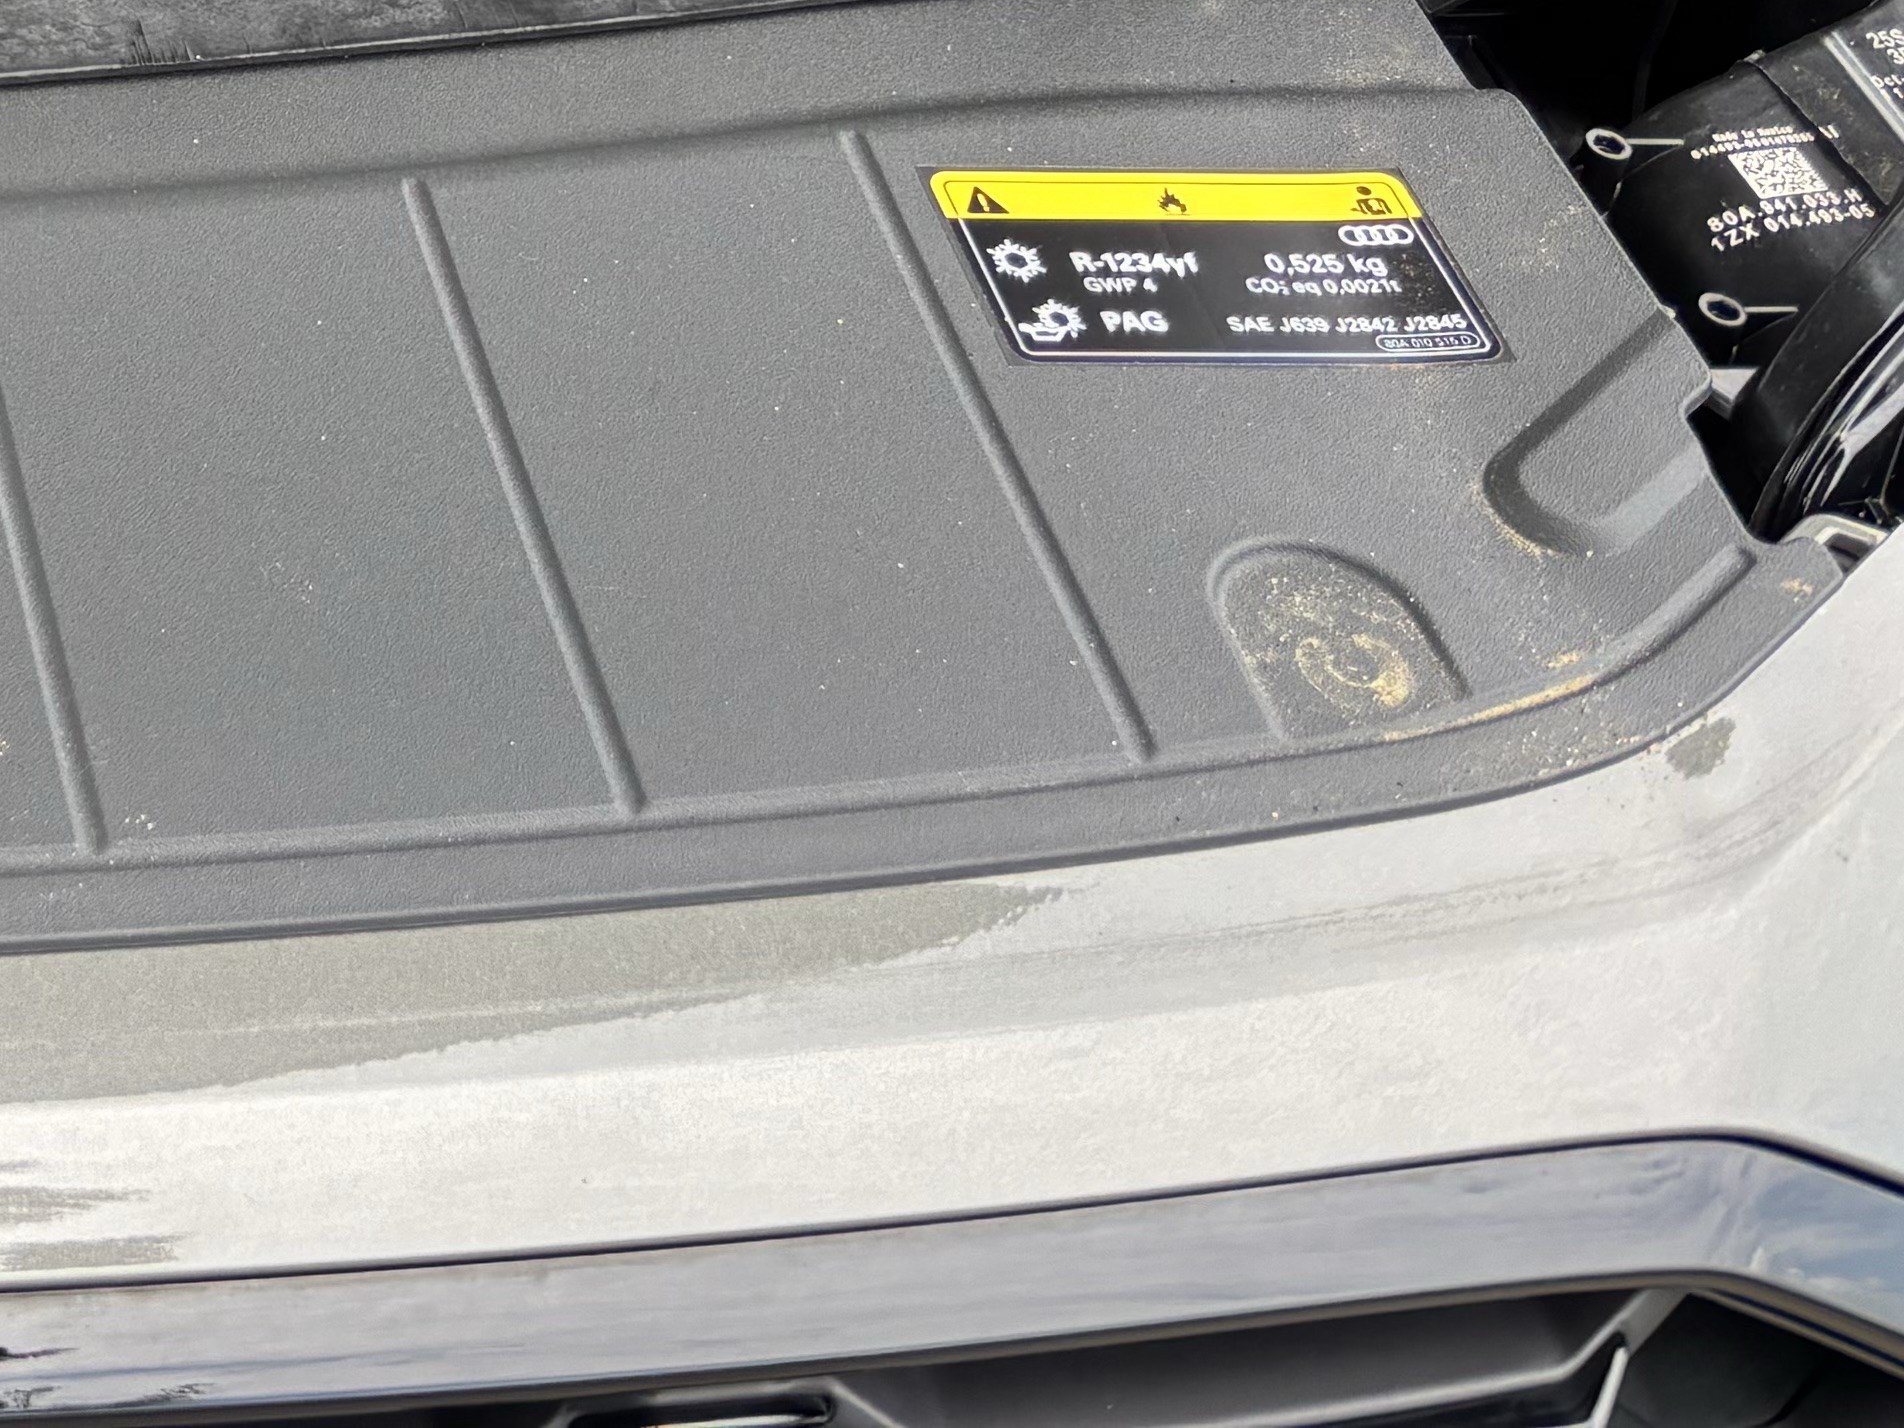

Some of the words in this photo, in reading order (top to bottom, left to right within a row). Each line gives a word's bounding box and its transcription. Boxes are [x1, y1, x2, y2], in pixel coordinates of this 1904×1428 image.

[1710, 223, 1760, 252] 1ZX
[1068, 251, 1199, 281] R-1234yf
[1263, 252, 1345, 277] 0,525
[1346, 253, 1389, 278] kg
[1083, 276, 1137, 293] GWP
[1142, 277, 1158, 293] 4
[1291, 281, 1323, 297] eq
[1099, 310, 1169, 333] PAG
[1226, 315, 1275, 333] SAE
[1279, 316, 1331, 334] J639
[1334, 315, 1399, 334] J2842
[1403, 314, 1472, 334] J2845
